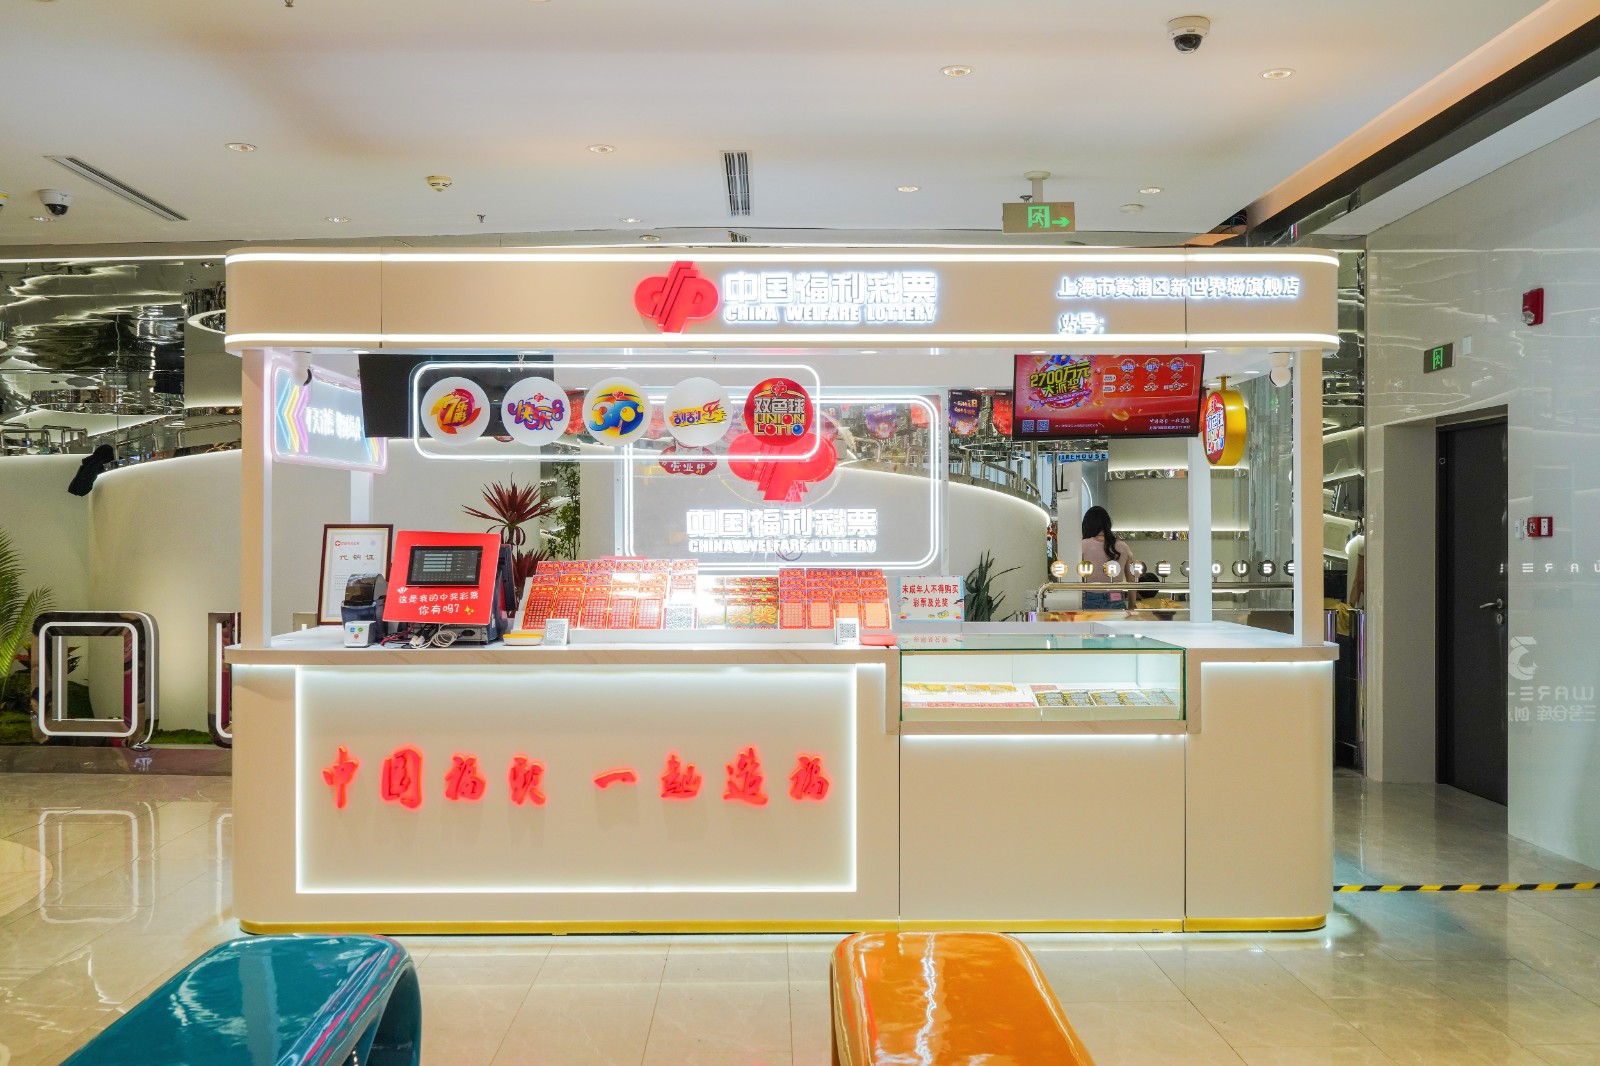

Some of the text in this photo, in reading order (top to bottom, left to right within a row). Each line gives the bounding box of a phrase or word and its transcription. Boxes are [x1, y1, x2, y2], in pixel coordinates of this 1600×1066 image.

[724, 271, 937, 304] 中国福利彩票
[1057, 276, 1300, 298] 上海市黄浦区新世界城旗舰店
[726, 306, 936, 322] CHINA WELFARE LOTTERY
[1030, 361, 1091, 387] 2700万元
[1042, 378, 1081, 398] 大派奖
[754, 397, 805, 413] 双色球
[754, 413, 805, 425] UNION
[754, 424, 804, 436] LOTTO
[670, 461, 706, 474] 营业中
[686, 508, 879, 537] 中国福利彩票
[688, 538, 877, 552] CHINA WELFARE LOTTERY
[902, 584, 959, 594] 未成年人不得购买
[398, 591, 479, 604] 这是我的中奖彩票
[913, 597, 949, 608] 彩票及兑奖
[593, 745, 832, 807] 一起造福
